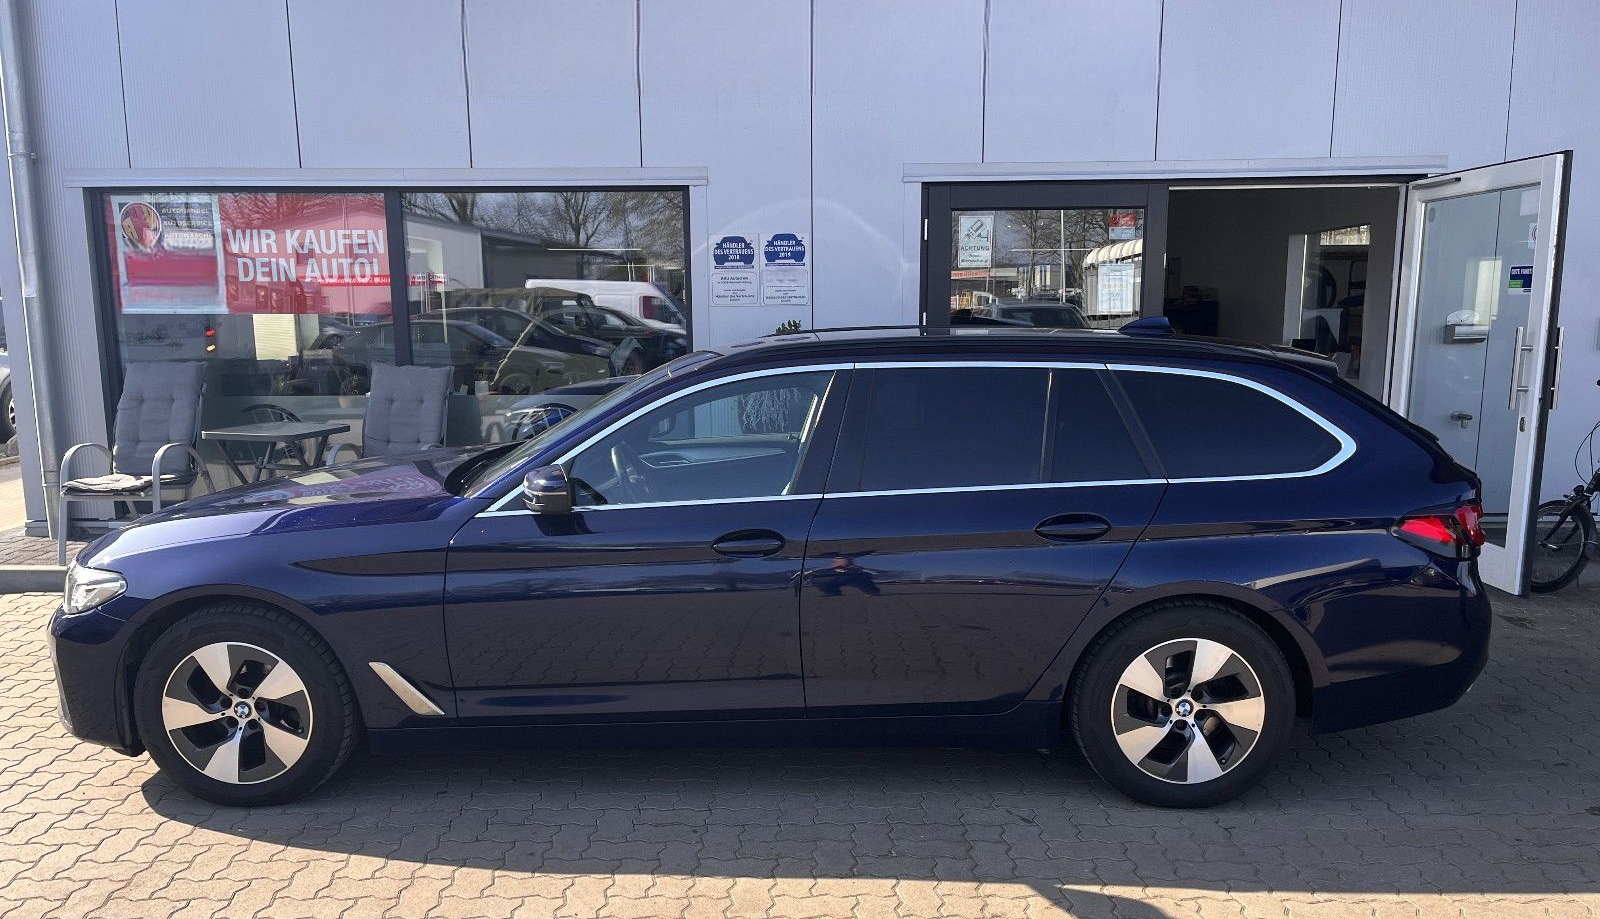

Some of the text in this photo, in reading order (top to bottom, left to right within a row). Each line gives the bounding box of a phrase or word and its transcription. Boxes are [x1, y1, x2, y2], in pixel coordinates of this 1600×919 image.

[227, 229, 385, 254] WIR KAUFEN
[237, 257, 296, 282] DEIN
[305, 257, 379, 282] AUTO!
